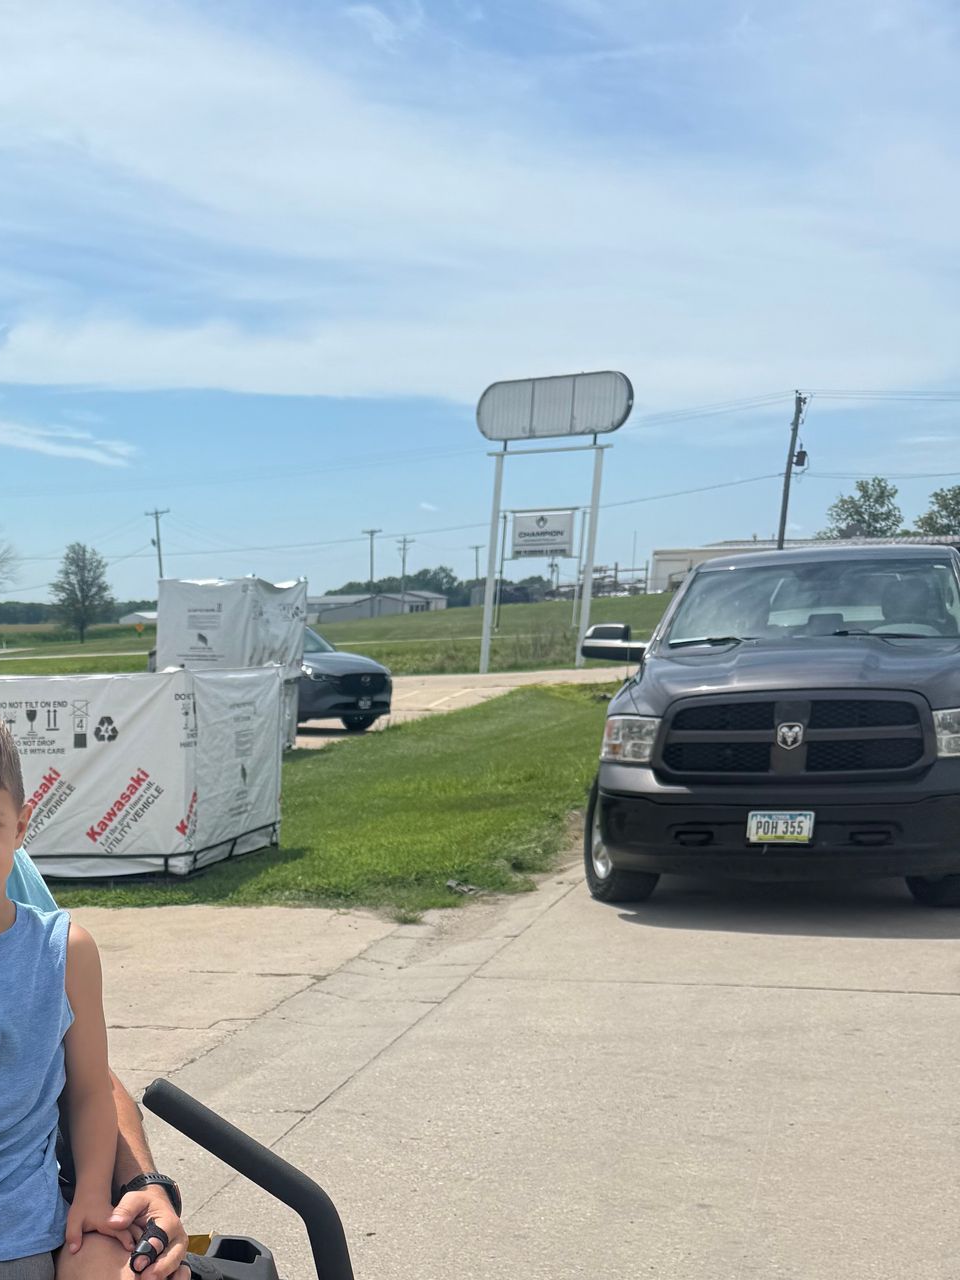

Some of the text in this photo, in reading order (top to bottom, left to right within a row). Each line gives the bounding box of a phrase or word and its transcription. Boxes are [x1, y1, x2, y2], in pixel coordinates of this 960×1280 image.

[518, 530, 565, 538] CHAMPION
[8, 701, 23, 709] NOT
[26, 767, 61, 810] asaki
[43, 783, 77, 820] VEHICLE
[86, 768, 150, 843] Kawasaki
[105, 785, 164, 855] UTILITY VEHICLE
[756, 820, 804, 835] POH 355
